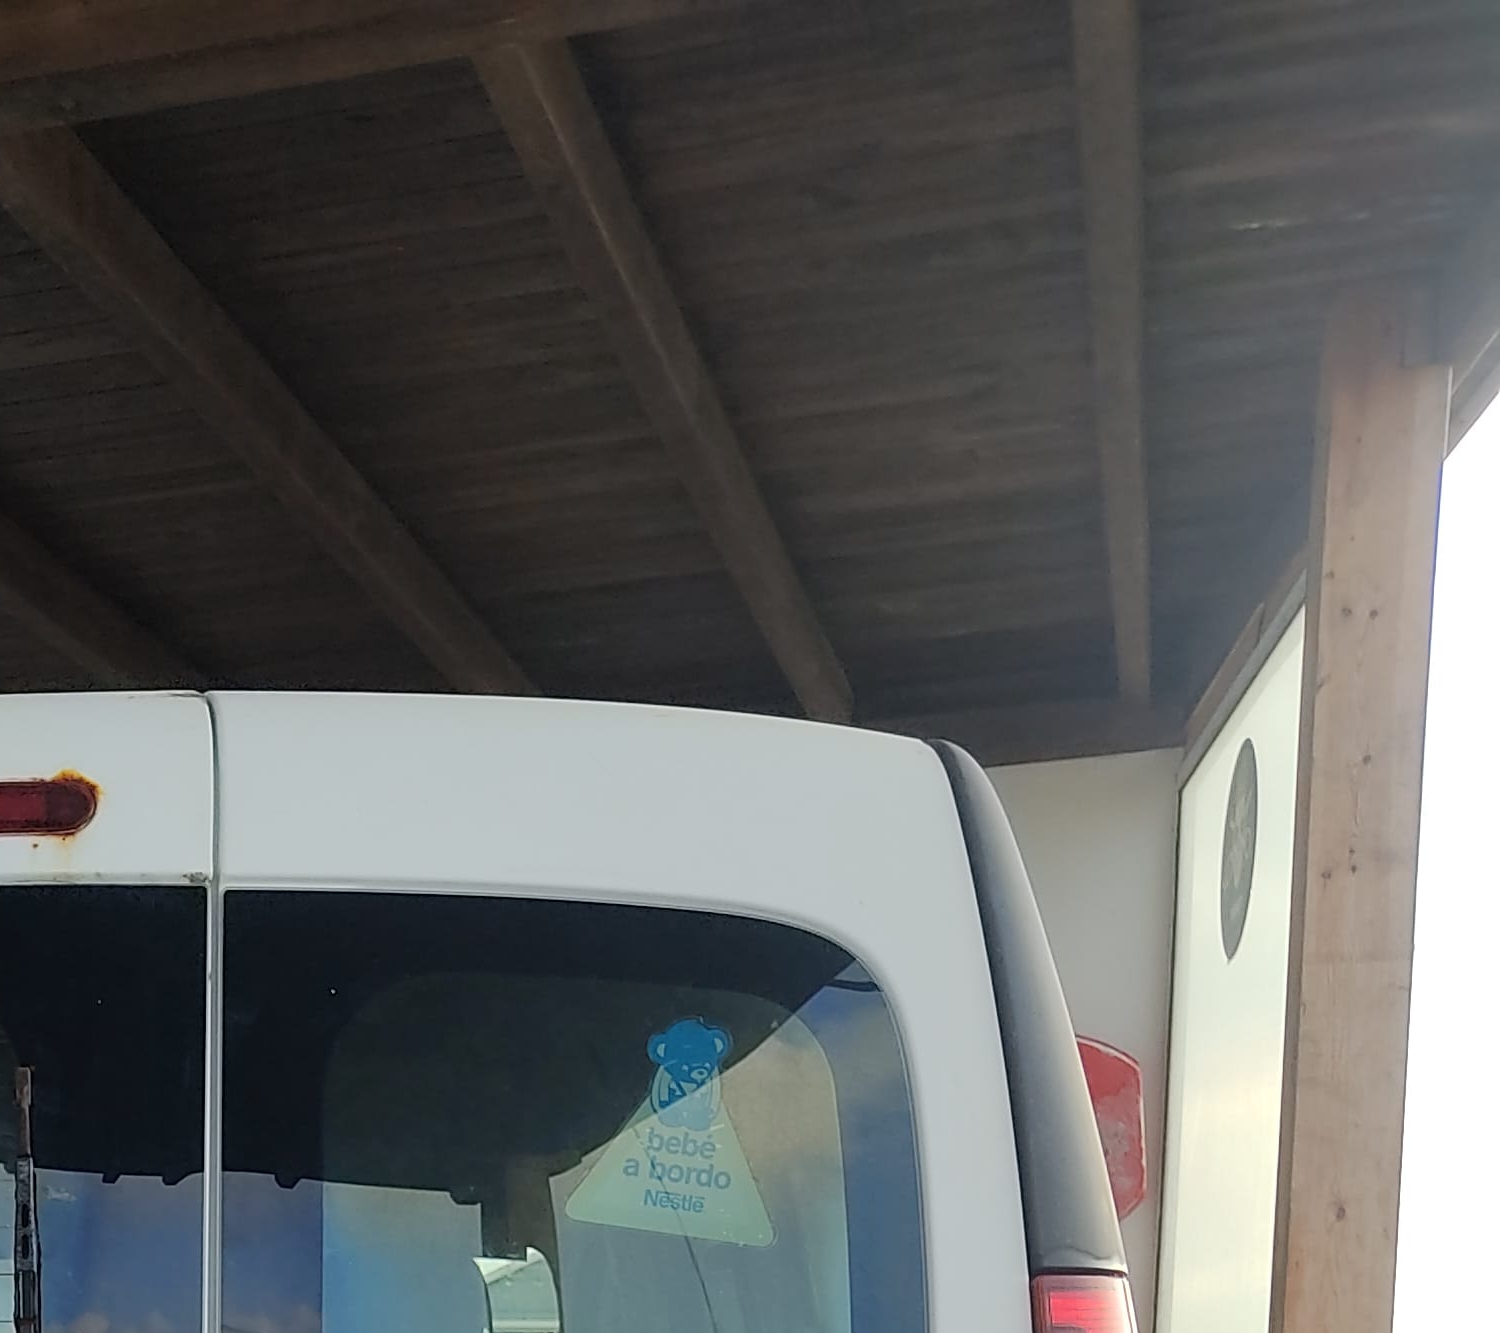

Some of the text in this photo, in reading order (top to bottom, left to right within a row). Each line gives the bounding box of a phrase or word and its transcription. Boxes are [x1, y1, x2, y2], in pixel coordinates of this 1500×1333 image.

[647, 1127, 716, 1159] bebé
[623, 1155, 731, 1189] a bordo
